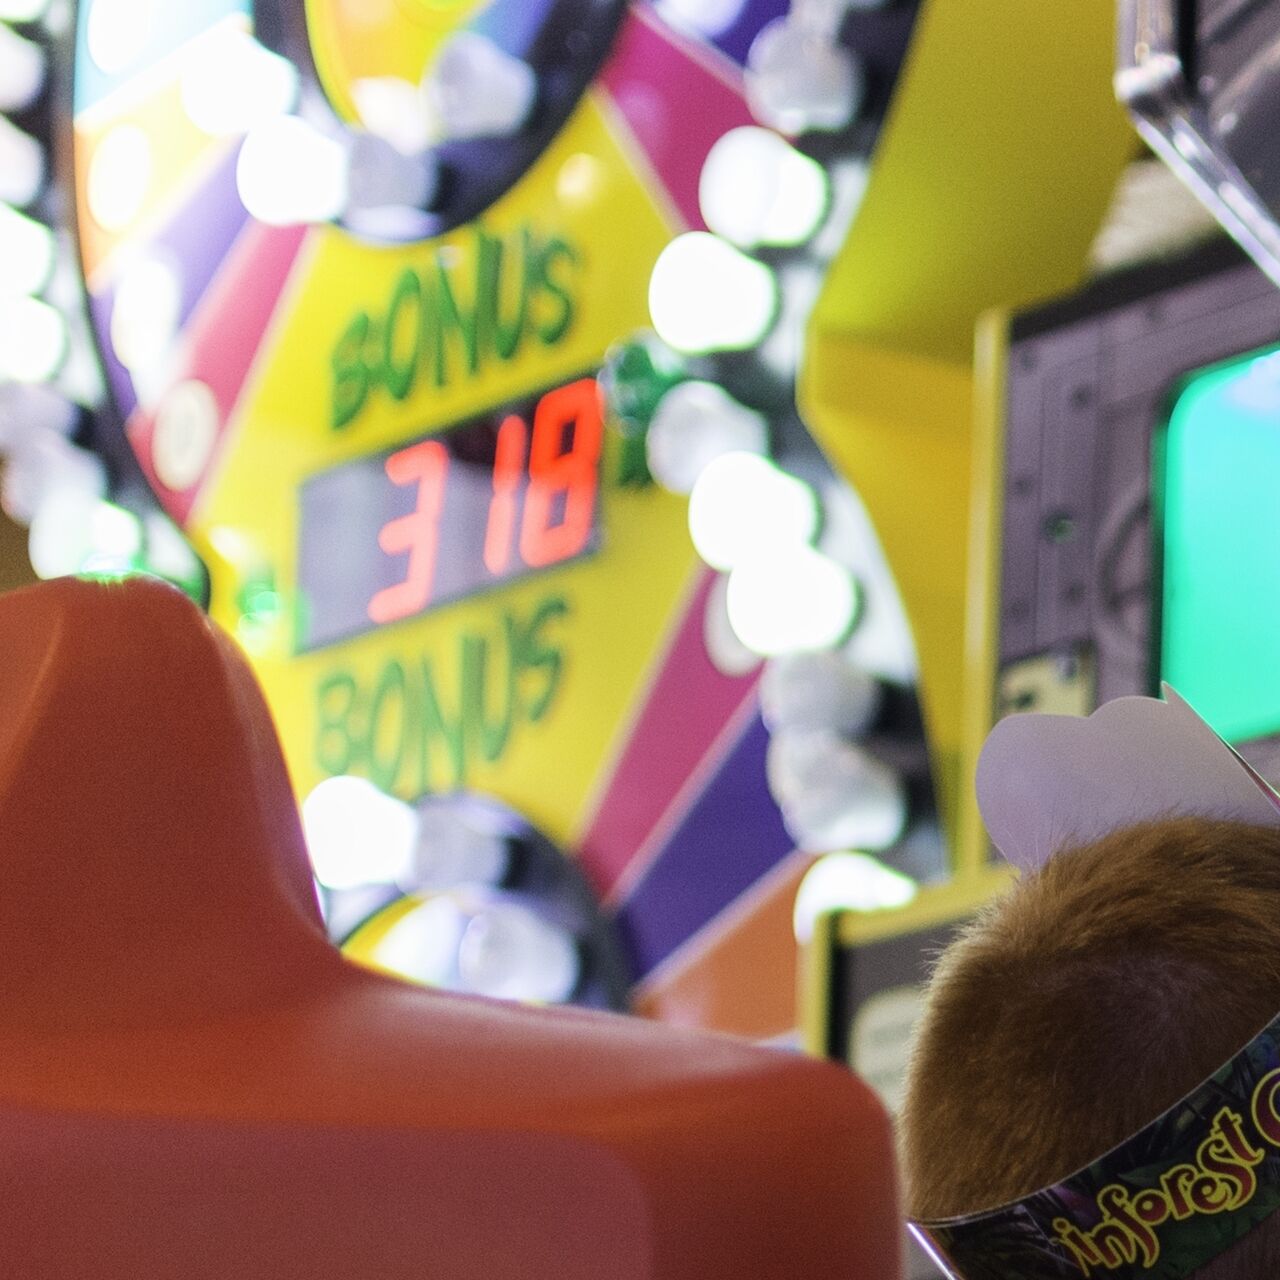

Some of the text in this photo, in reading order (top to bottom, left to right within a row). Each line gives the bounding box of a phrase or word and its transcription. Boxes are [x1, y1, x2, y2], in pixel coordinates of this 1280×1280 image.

[330, 224, 582, 430] BONUS
[368, 377, 605, 624] 318
[314, 598, 568, 800] BONUS
[1052, 1106, 1265, 1277] inforest
